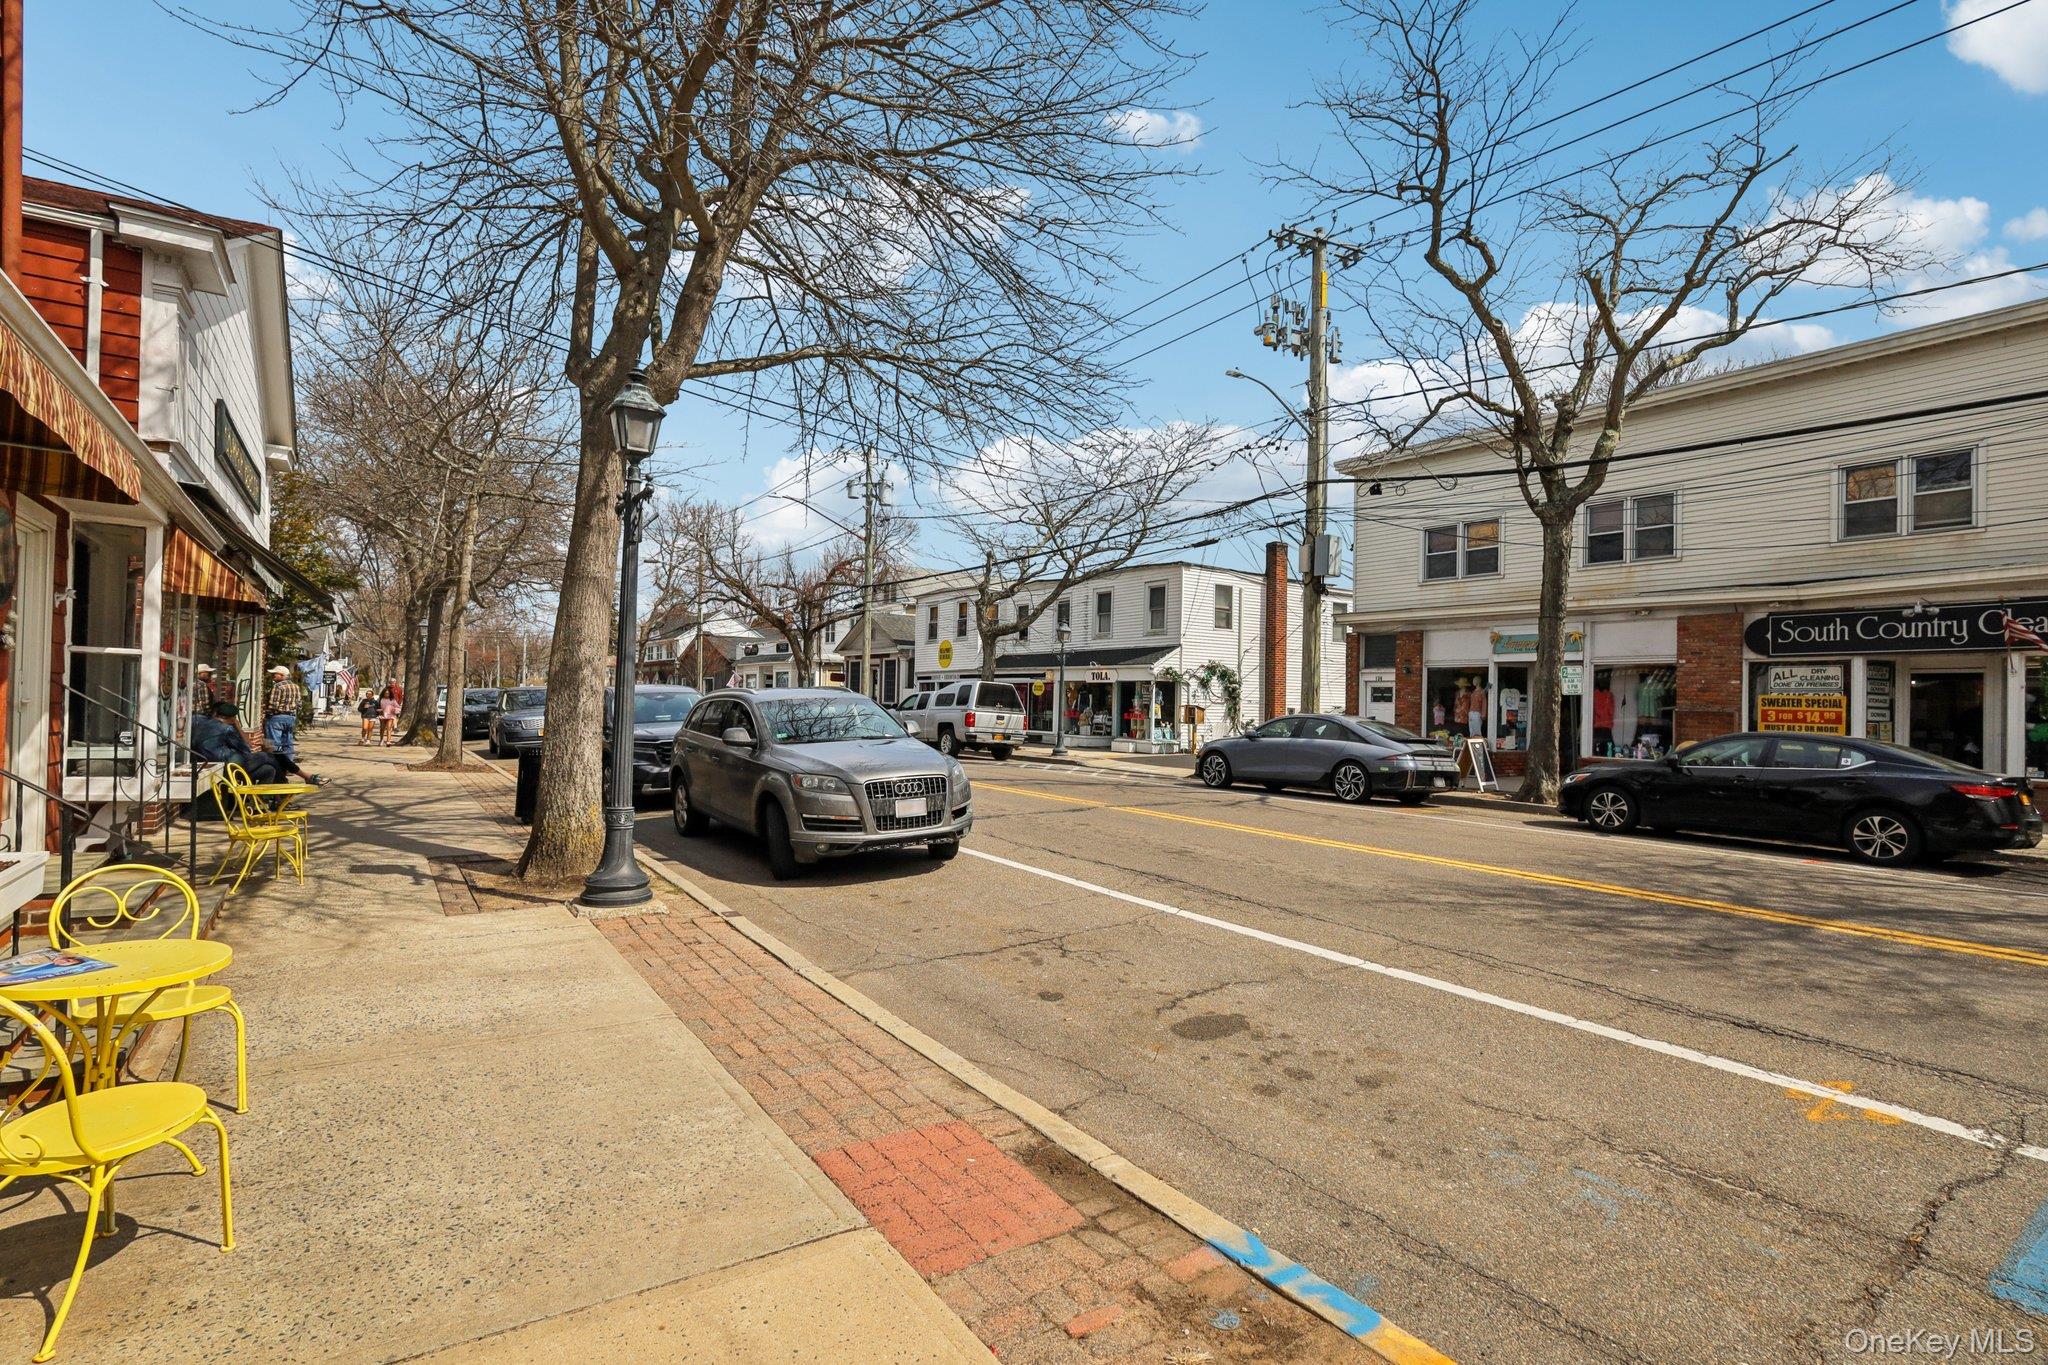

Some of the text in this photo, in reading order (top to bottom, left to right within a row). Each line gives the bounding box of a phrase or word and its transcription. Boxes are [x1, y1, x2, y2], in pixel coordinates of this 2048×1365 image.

[1778, 617, 1849, 643] South
[1856, 615, 1968, 644] Country
[1773, 669, 1798, 682] ALL
[1761, 697, 1843, 708] SWEATER SPECIAL
[1767, 710, 1776, 721] 3
[1778, 712, 1793, 720] FOR
[1816, 725, 1839, 733] MORE
